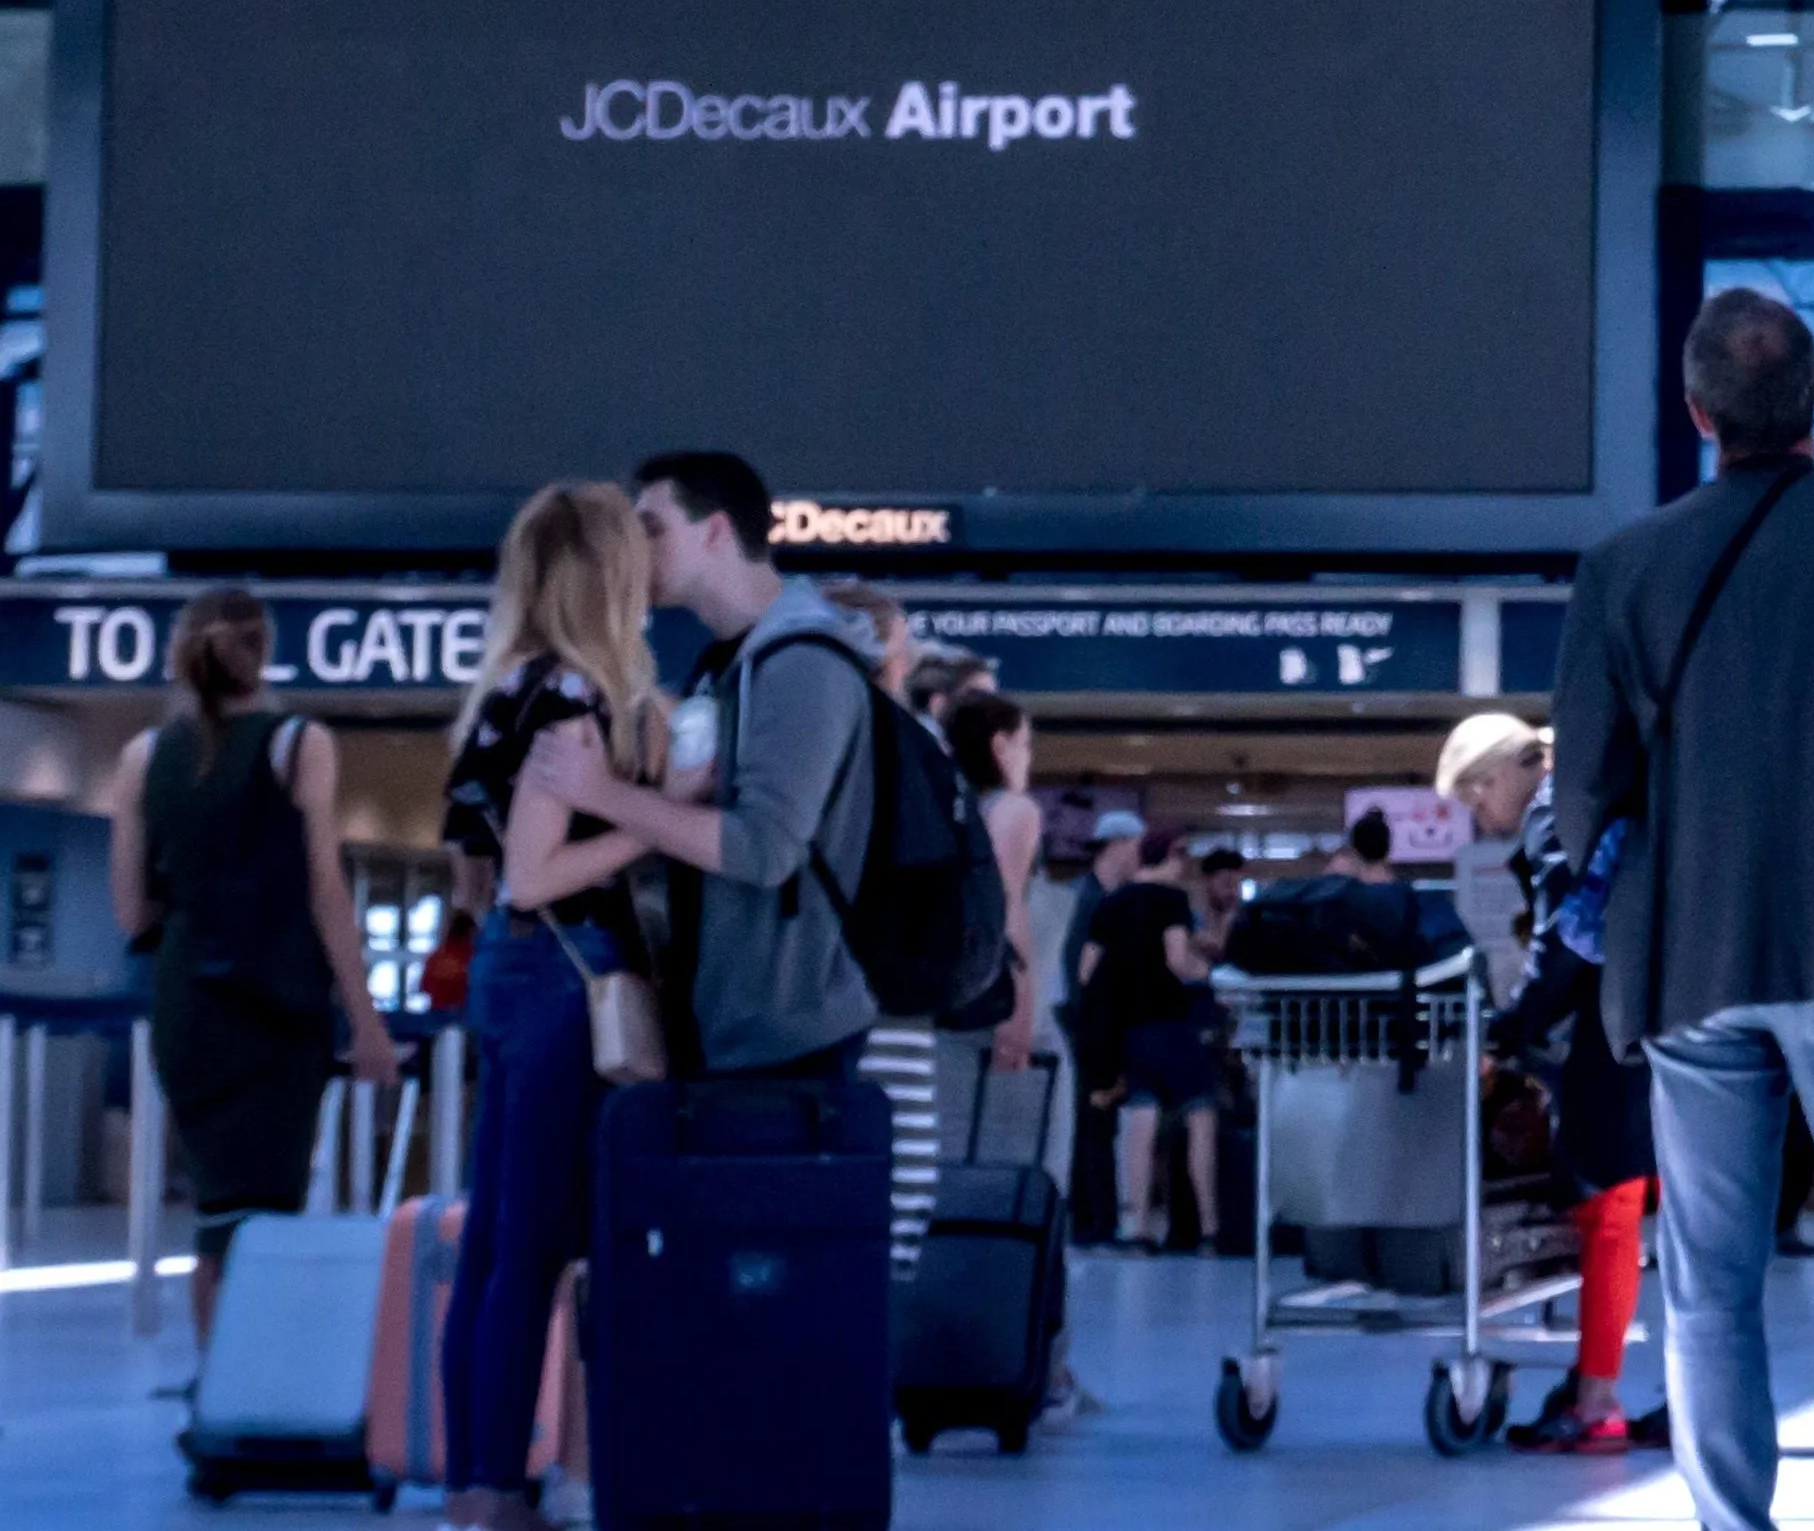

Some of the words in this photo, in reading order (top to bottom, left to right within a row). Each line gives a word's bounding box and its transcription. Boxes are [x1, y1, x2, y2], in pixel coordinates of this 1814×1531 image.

[560, 79, 871, 141] JCDecaux
[884, 80, 1137, 152] Airport
[54, 606, 155, 682] TO
[306, 608, 490, 683] GATE
[933, 610, 991, 636] YOUR
[992, 610, 1101, 637] PASSPORT
[1102, 611, 1151, 636] AND
[1152, 611, 1262, 637] BOARDING
[1263, 611, 1319, 637] PASS
[1320, 611, 1393, 637] READY
